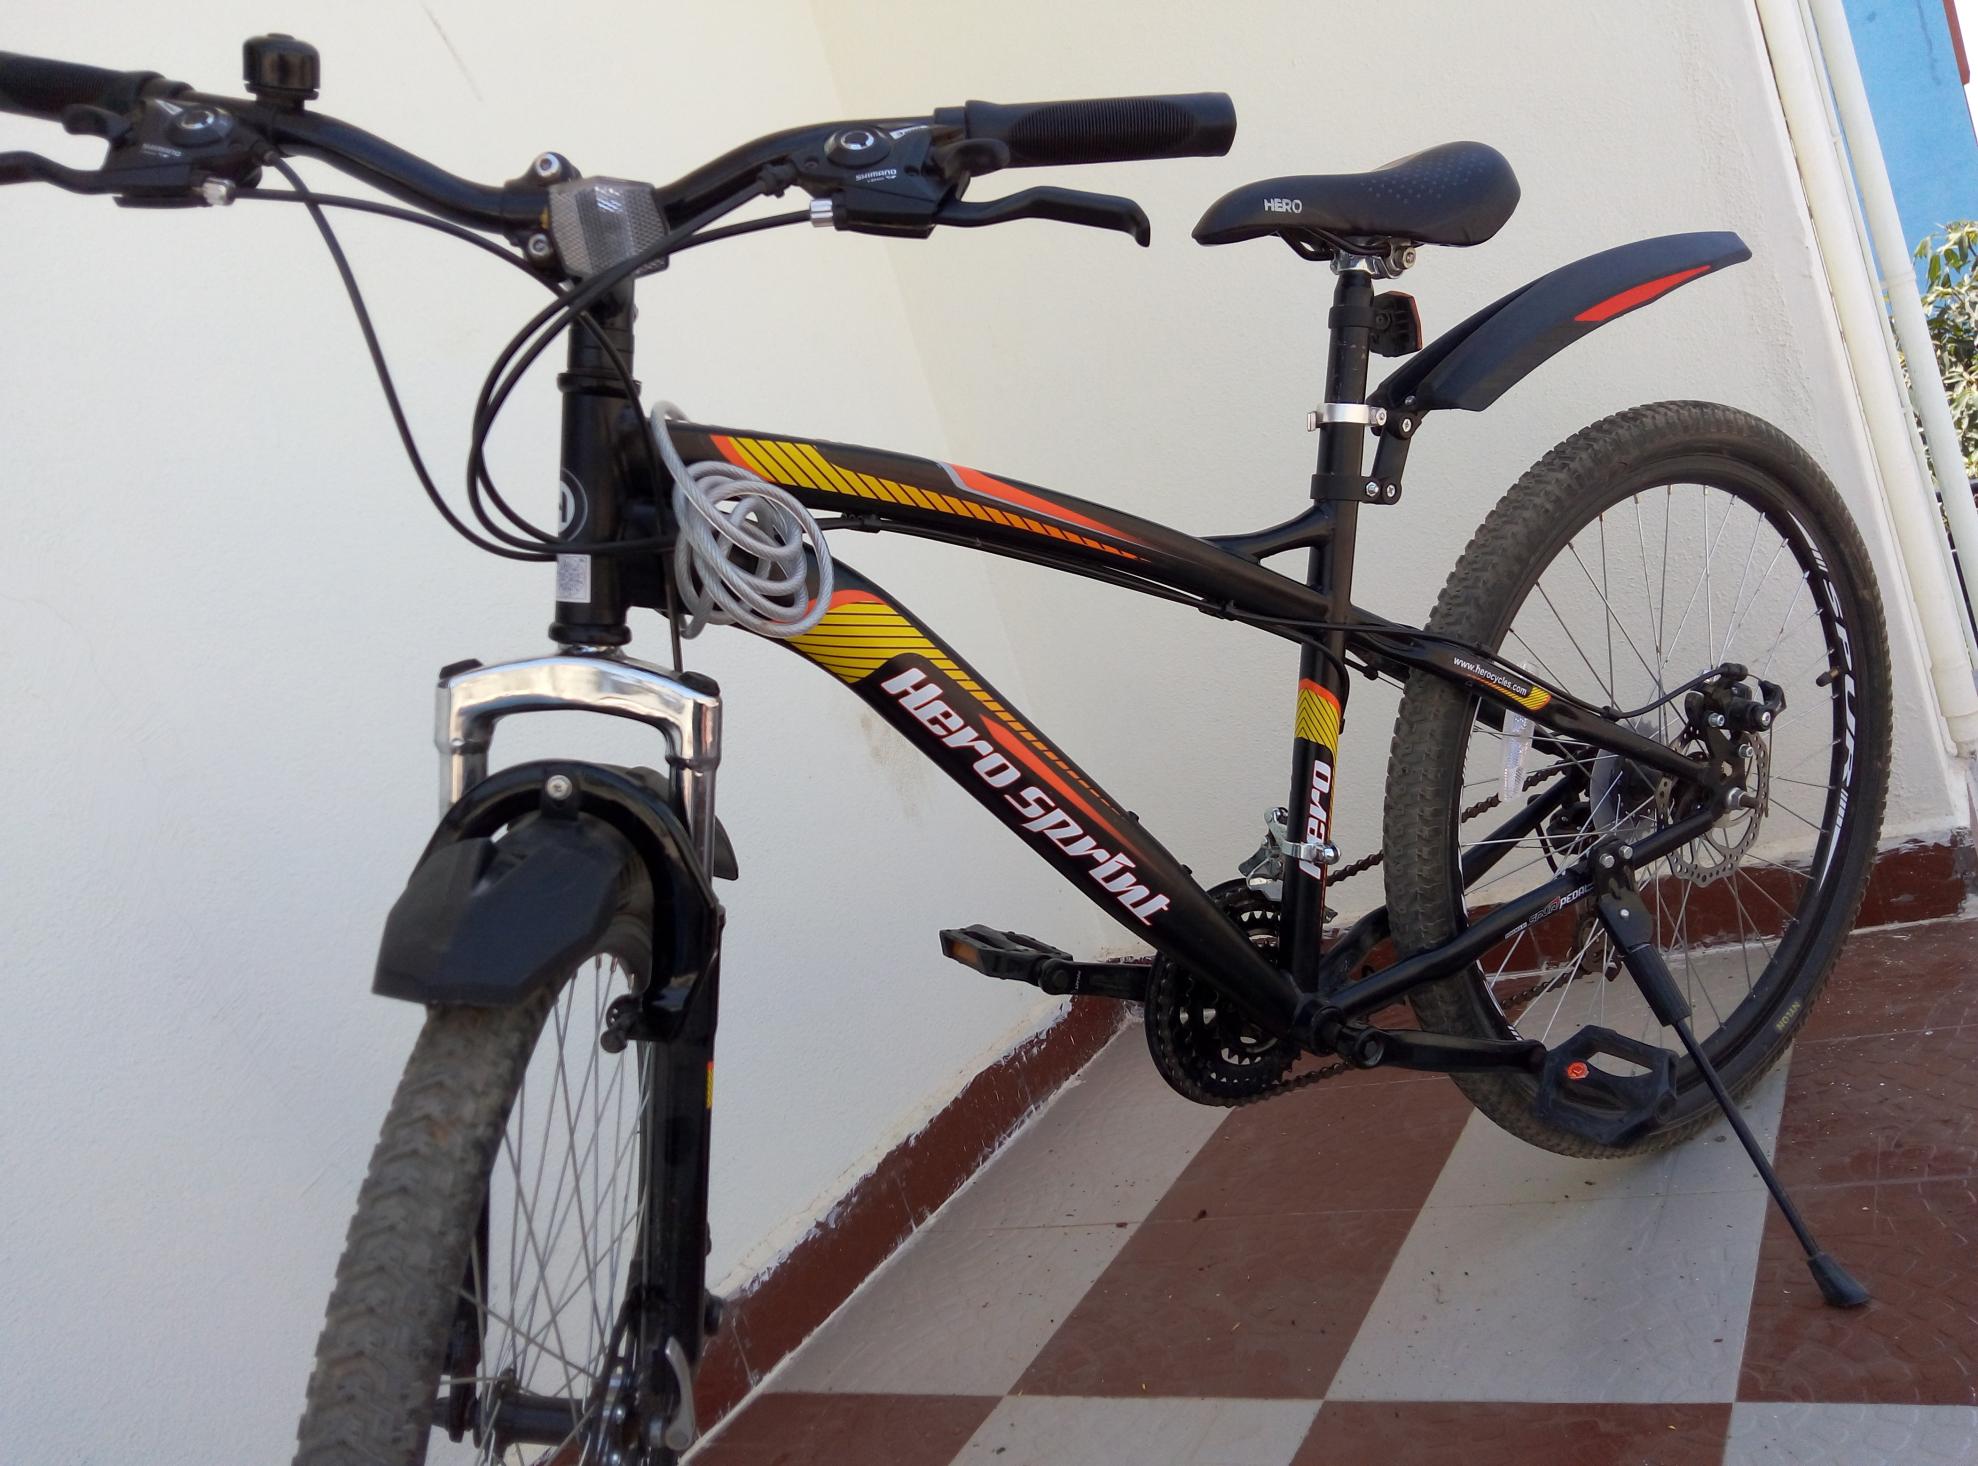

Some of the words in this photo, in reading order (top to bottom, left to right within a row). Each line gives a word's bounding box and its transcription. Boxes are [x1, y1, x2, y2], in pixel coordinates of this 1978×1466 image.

[1263, 199, 1303, 214] HERO
[1453, 656, 1528, 696] www.herocycles.com
[1822, 578, 1856, 788] SPUR
[880, 667, 1021, 789] Hero
